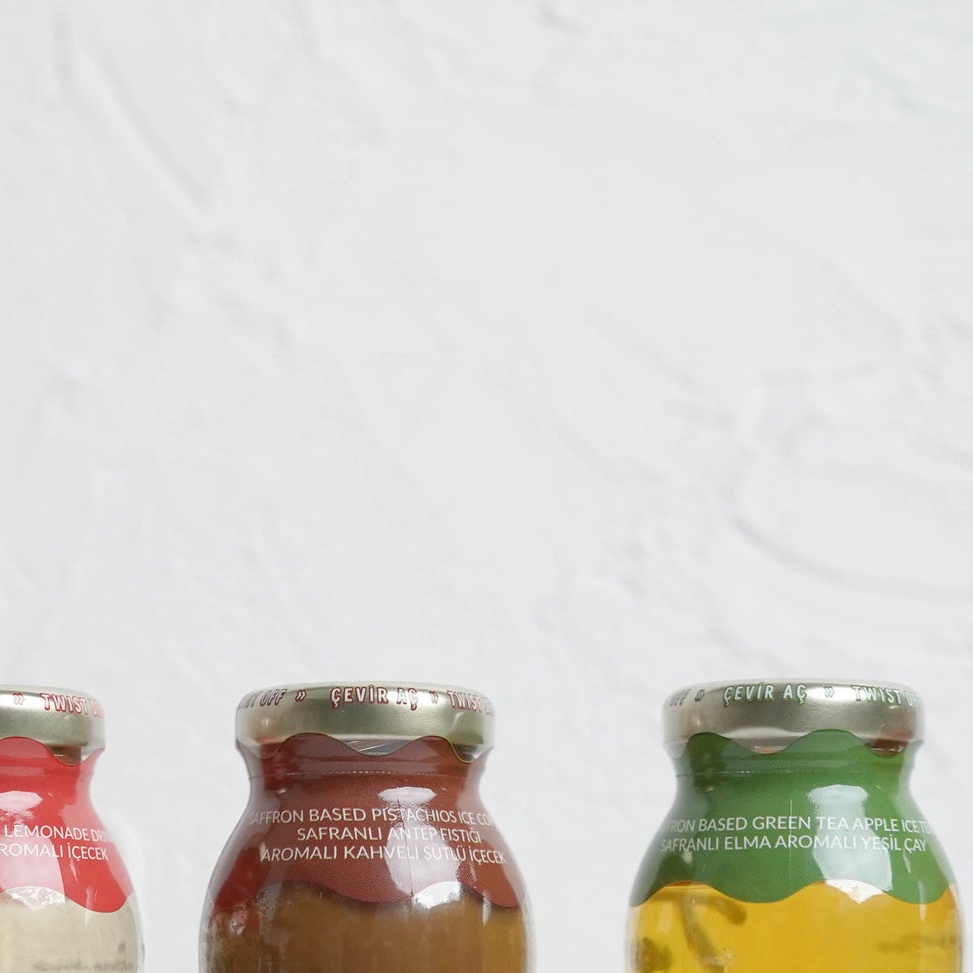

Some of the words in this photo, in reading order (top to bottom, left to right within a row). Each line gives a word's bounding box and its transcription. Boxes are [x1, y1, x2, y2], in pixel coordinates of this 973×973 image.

[40, 692, 88, 715] TWIST
[330, 684, 389, 709] ÇEVİR
[396, 687, 420, 711] AÇ
[722, 681, 776, 707] ÇEVİR
[783, 684, 808, 705] AÇ
[851, 684, 902, 705] TWIST
[249, 810, 304, 825] SAFFRON
[309, 808, 367, 822] BASED
[371, 808, 457, 824] PISTACHIOS
[458, 811, 476, 825] ICE
[698, 817, 748, 832] BASED
[752, 816, 811, 830] GREEN
[816, 816, 850, 830] TEA
[852, 817, 899, 832] APPLE
[901, 819, 920, 834] ICE
[4, 824, 90, 842] LEMONADE
[297, 826, 383, 841] SAFRANLI
[387, 826, 437, 841] ANTEP
[439, 828, 483, 844] FISTIĞI
[67, 842, 109, 862] İÇECEK
[660, 836, 719, 853] SAFRANLI
[724, 835, 772, 851] ELMA
[774, 835, 856, 850] AROMALI
[861, 834, 902, 853] YEŞİL
[903, 837, 927, 853] ÇAY
[260, 845, 337, 863] AROMALI
[343, 845, 418, 861] KAHVELI
[423, 844, 467, 862] SÜTLÜ
[468, 845, 507, 865] İÇECEK
